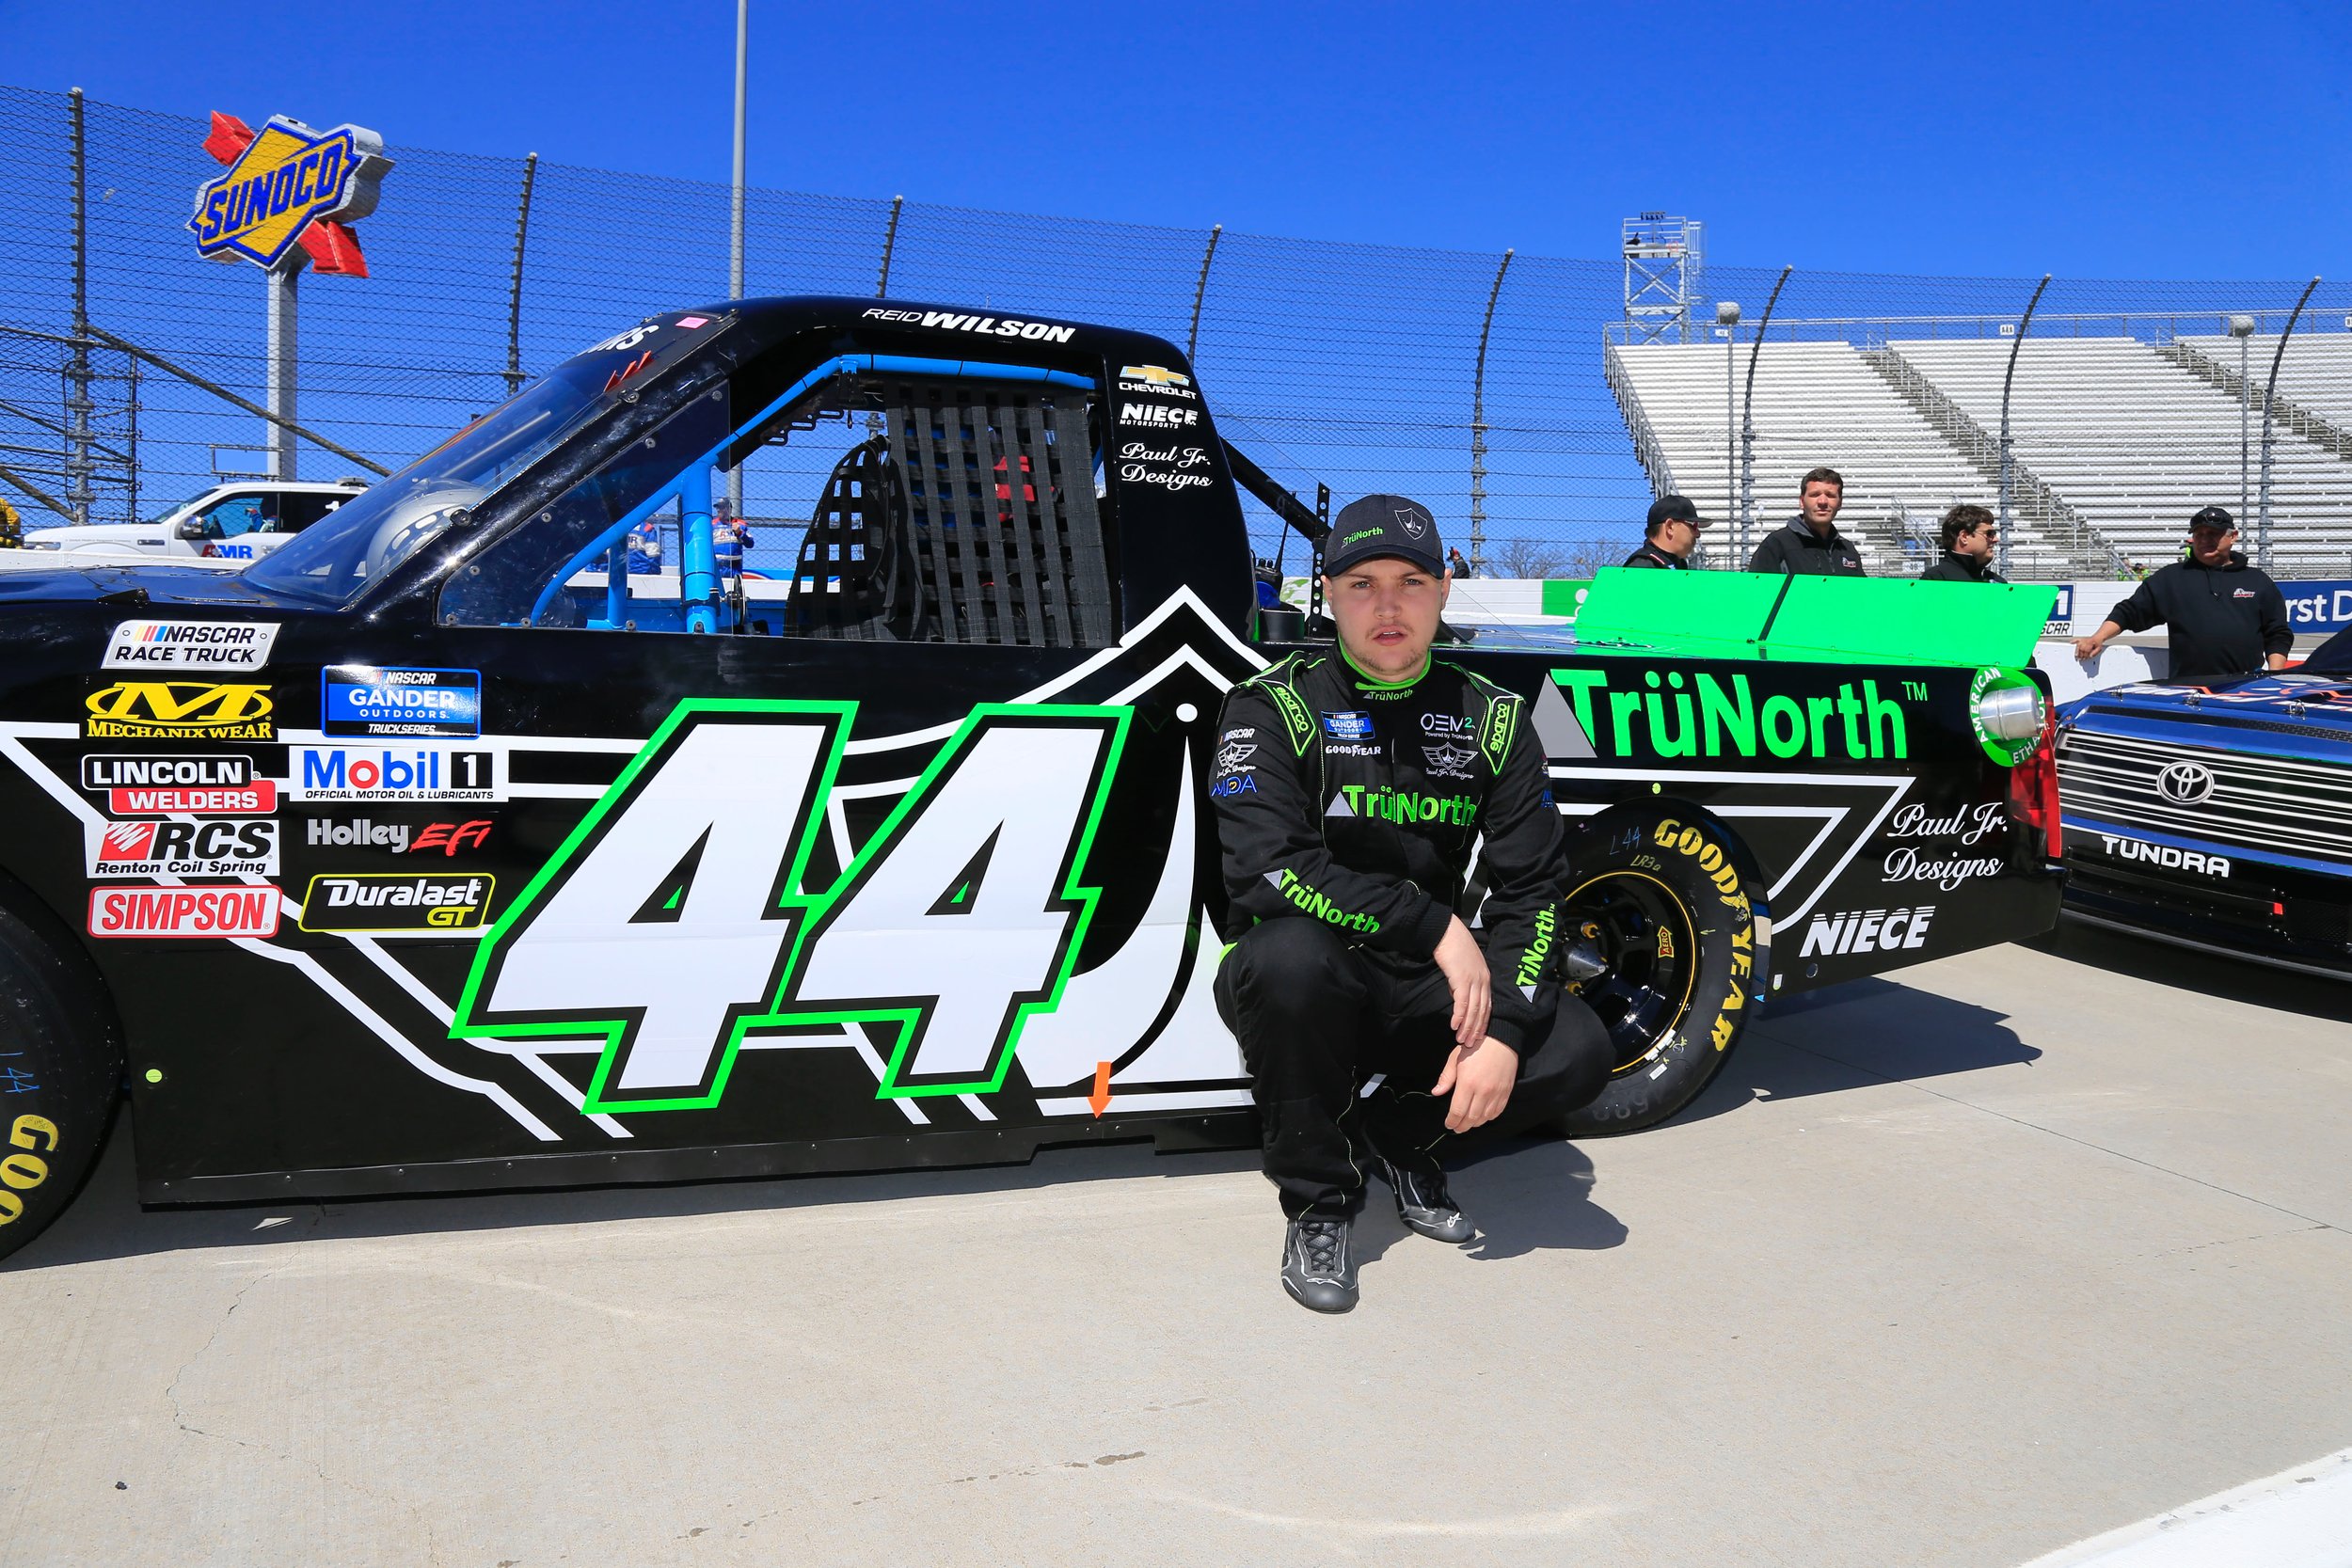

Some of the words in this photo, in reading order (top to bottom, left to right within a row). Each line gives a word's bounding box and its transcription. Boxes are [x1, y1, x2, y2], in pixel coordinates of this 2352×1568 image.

[202, 143, 344, 241] SUNOCO
[862, 308, 923, 322] REID
[920, 311, 1076, 343] WILSON
[1119, 382, 1197, 400] CHEVROLET
[1120, 403, 1199, 425] NIECE
[1120, 419, 1179, 430] MOTORSPORTS
[1119, 442, 1178, 462] Paul
[1177, 447, 1211, 468] Jr.
[1120, 463, 1213, 491] Designs
[200, 543, 253, 559] AMR
[2285, 594, 2328, 623] rst
[165, 625, 256, 644] NASCAR
[2040, 622, 2071, 635] SCAR
[115, 646, 176, 661] RACE
[183, 646, 257, 663] TRUCK
[386, 672, 437, 686] NASCAR
[348, 688, 456, 708] GANDER
[1369, 689, 1413, 701] TrüNorth
[1971, 667, 2001, 743] AMERICAN
[1329, 720, 1365, 728] GANDER
[1549, 668, 1908, 760] TrüNorth
[87, 719, 206, 739] MECHANIX
[210, 721, 273, 739] WEAR
[2013, 696, 2046, 765] ETHAOL
[1325, 744, 1382, 757] GOODYEAR
[94, 761, 243, 784] LINCOLN
[303, 750, 439, 789] Mobil
[462, 754, 477, 787] 1
[127, 791, 259, 809] WELDERS
[305, 789, 354, 799] OFFICIAL
[356, 790, 396, 799] MOTOR
[398, 790, 415, 799] OIL
[417, 790, 424, 799] &
[427, 791, 494, 800] LUBRICANTS
[1342, 784, 1477, 827] TrüNorth
[307, 818, 409, 853] Holley
[1886, 802, 1968, 837] Paul
[1962, 801, 2008, 846] Jr.
[150, 821, 275, 861] RCS
[95, 861, 161, 874] Renton
[167, 861, 203, 874] Coil
[209, 861, 266, 875] Spring
[1882, 847, 2004, 892] Designs
[2101, 835, 2231, 879] TUNDRA
[322, 879, 483, 907] Duralast
[457, 705, 1125, 1104] 44
[1279, 867, 1381, 934] TrüNorth
[102, 893, 268, 930] SIMPSON
[426, 906, 477, 927] GT
[1661, 930, 1670, 954] AERO
[1799, 905, 1936, 958] NIECE
